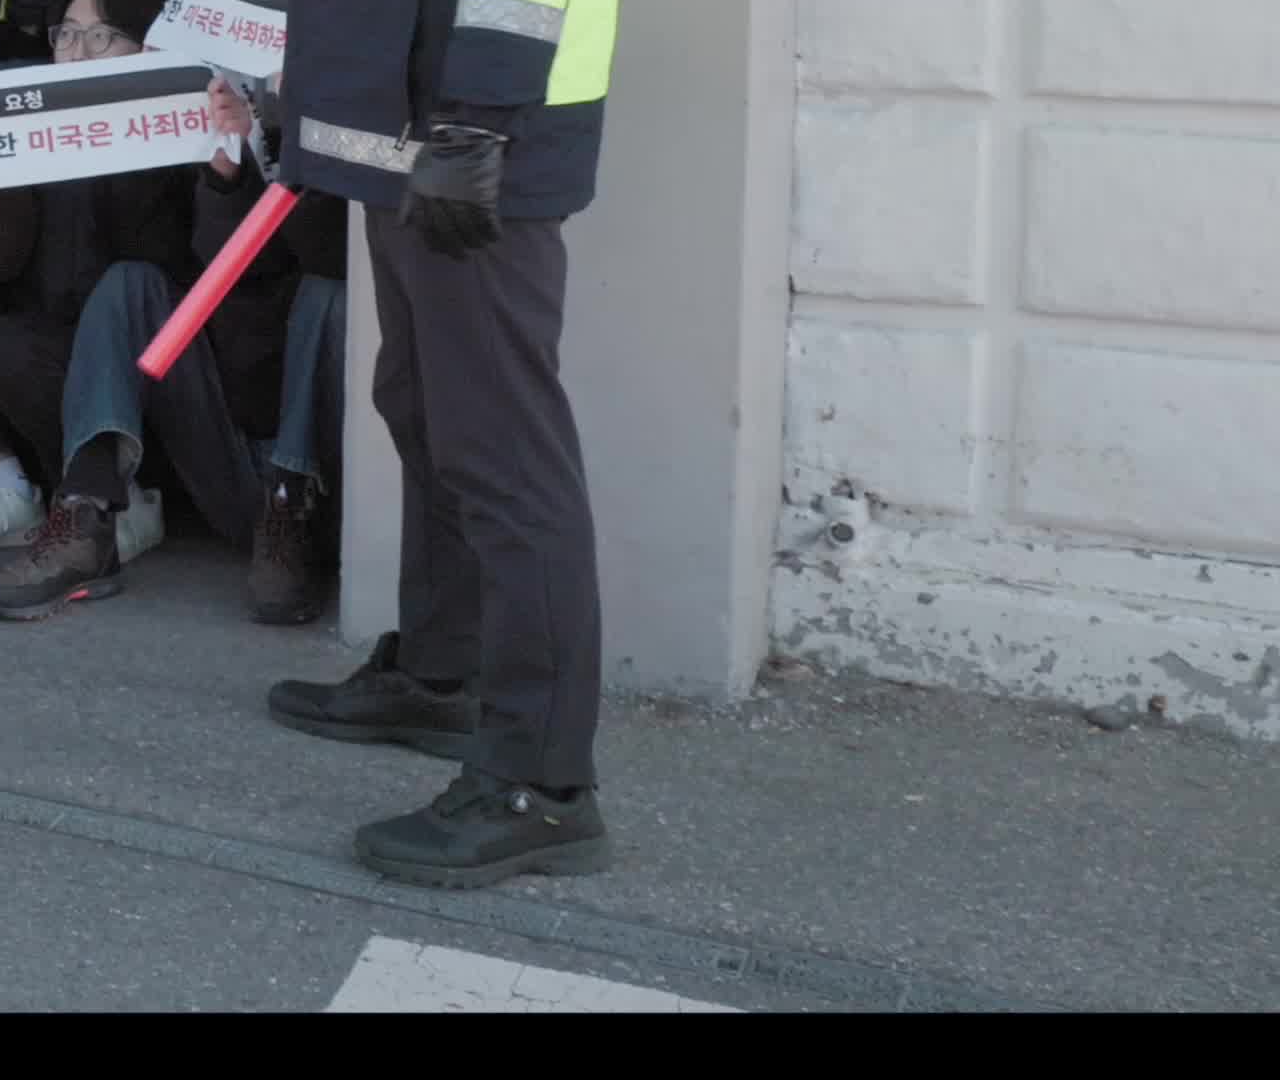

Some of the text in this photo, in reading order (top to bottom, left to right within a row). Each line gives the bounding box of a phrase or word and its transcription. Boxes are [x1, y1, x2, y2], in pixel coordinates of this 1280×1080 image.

[183, 4, 225, 37] 미국은
[4, 88, 44, 113] 요청
[28, 120, 113, 153] 미국은
[126, 105, 209, 141] 사죄하
